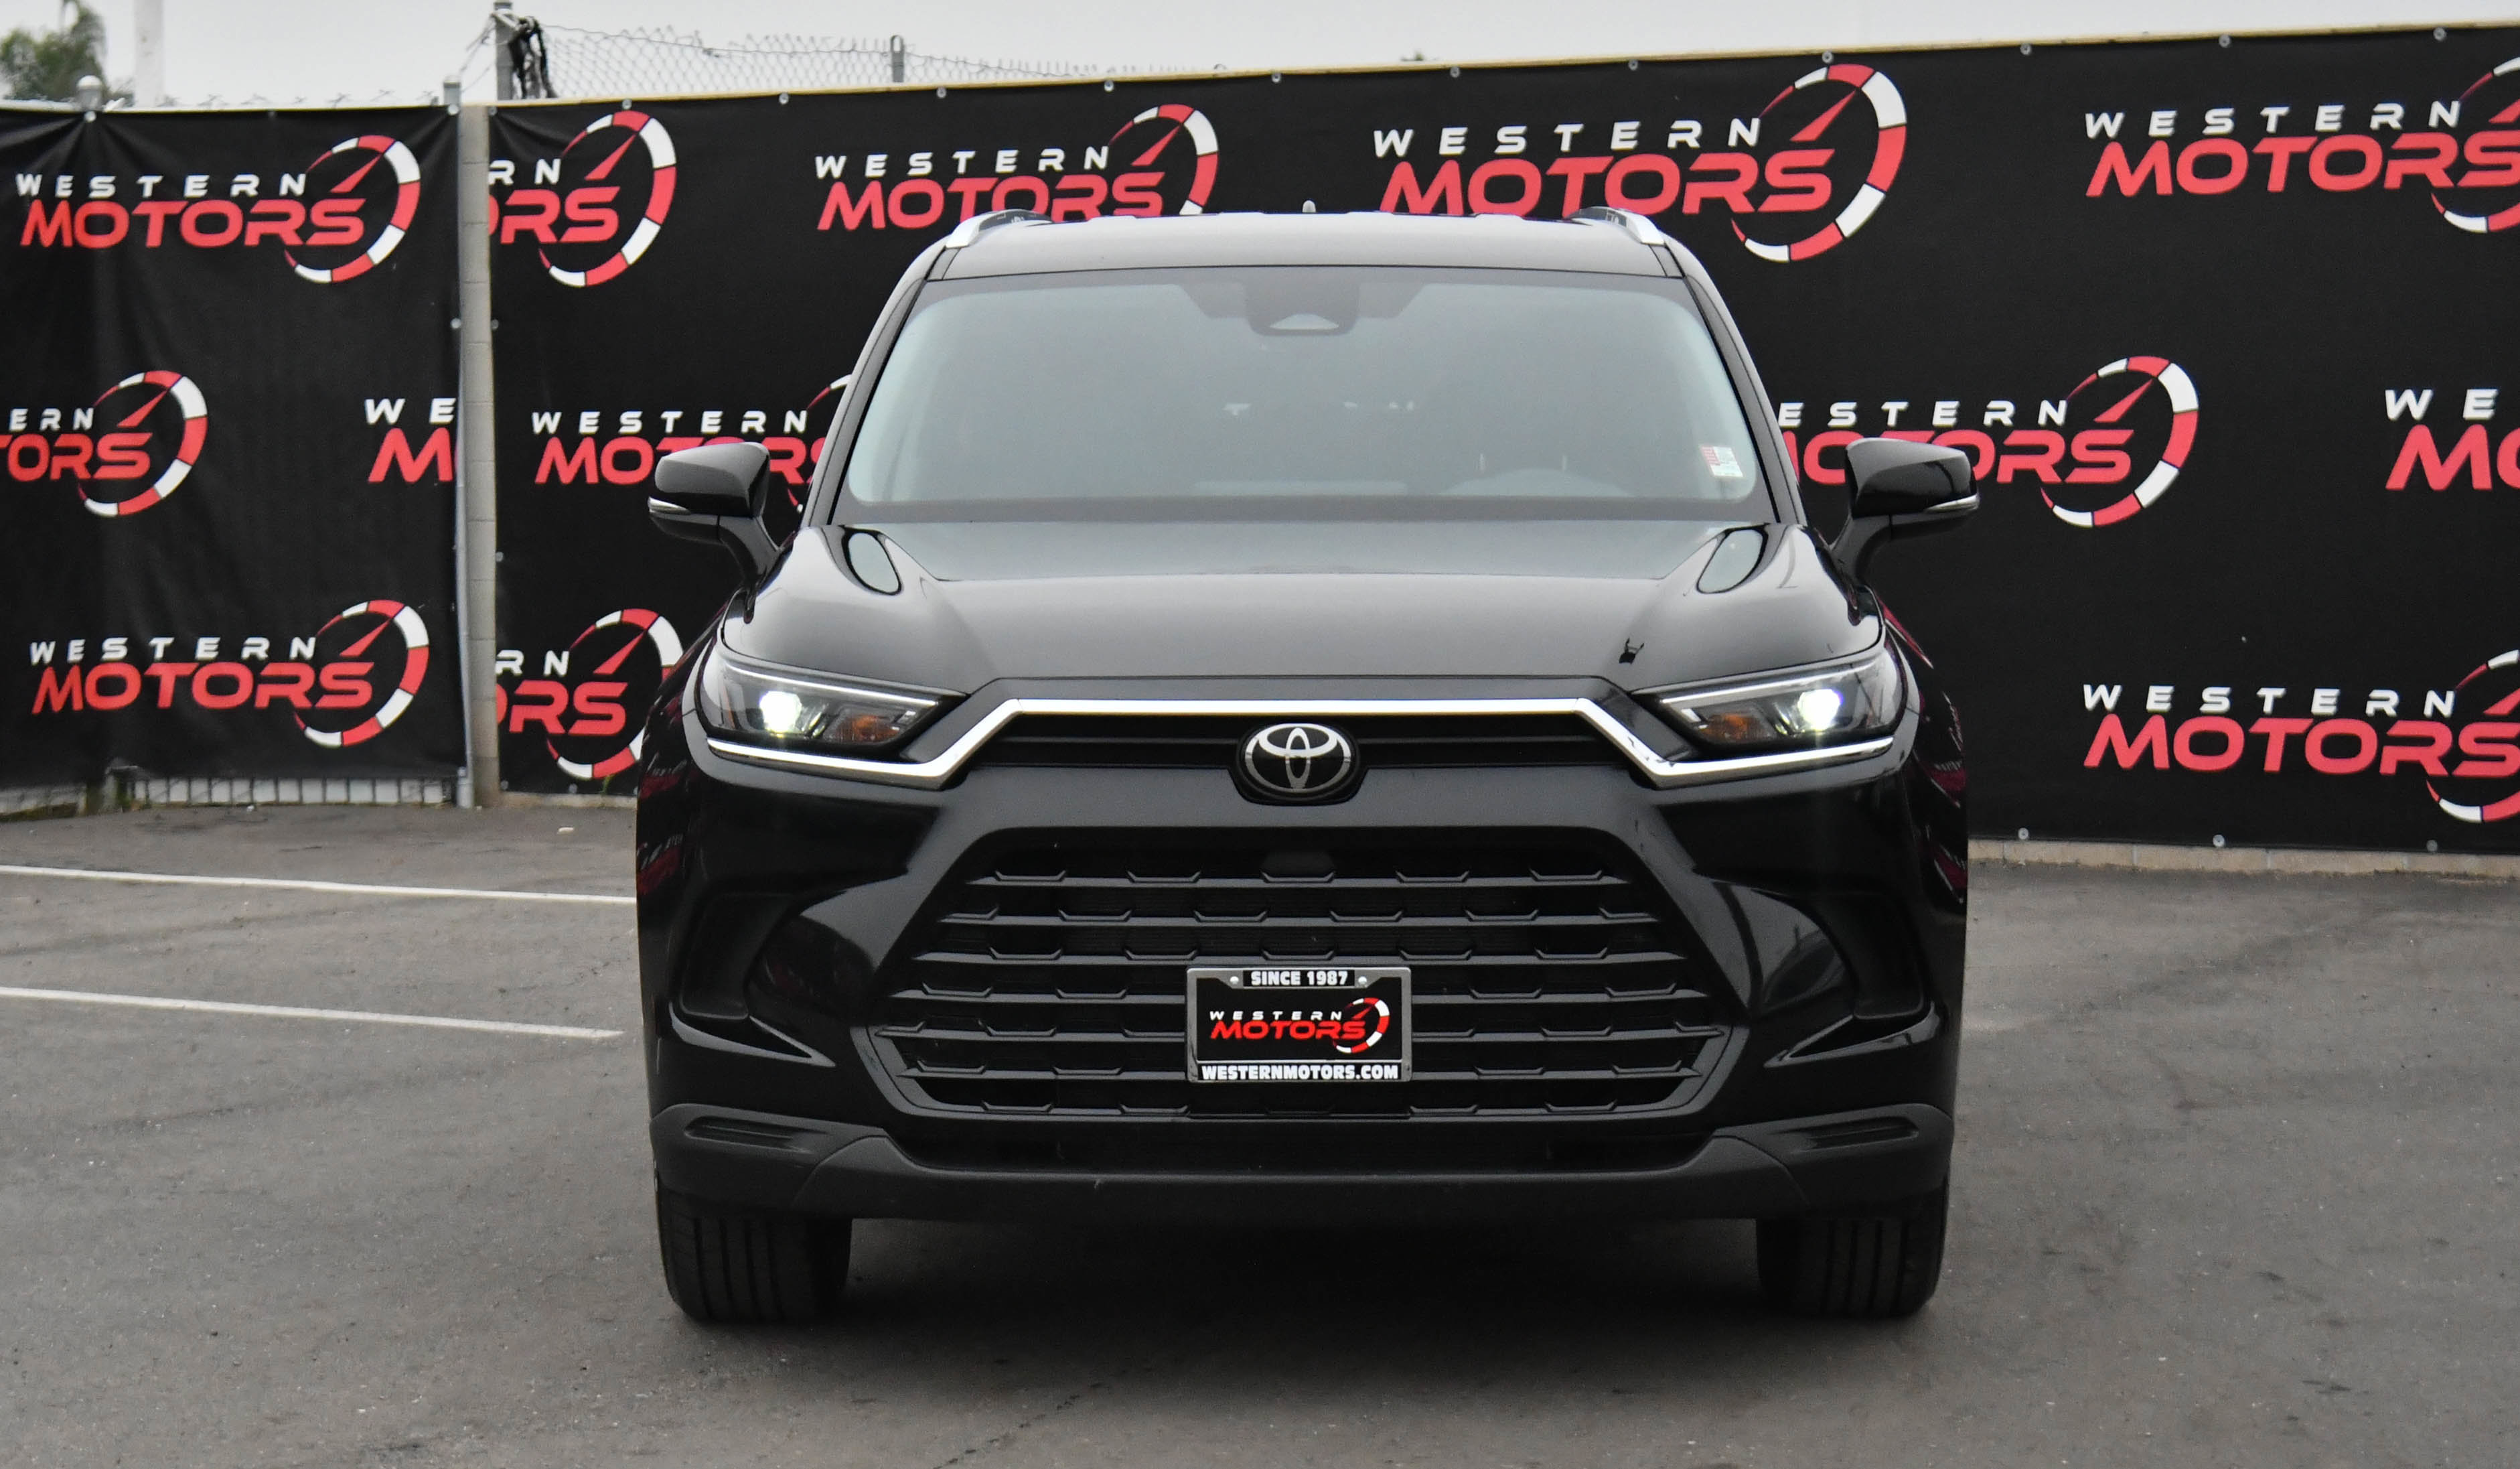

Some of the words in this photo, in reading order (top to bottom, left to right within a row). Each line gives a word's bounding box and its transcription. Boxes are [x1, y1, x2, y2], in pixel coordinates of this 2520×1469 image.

[1374, 118, 1760, 157] WESTERN
[2085, 100, 2460, 139] WESTERN
[815, 145, 1108, 178] WESTERN
[2086, 129, 2520, 196] MOTORS
[15, 173, 307, 198] WESTERN
[817, 171, 1165, 231] MOTORS
[1380, 148, 1835, 217] MOTORS
[21, 198, 366, 249] MOTORS
[489, 186, 621, 244] RS
[532, 410, 808, 434] WESTERN
[1777, 400, 2067, 427] ESTERN
[0, 432, 153, 482] ORS
[30, 636, 316, 664] WESTERN
[32, 661, 374, 714] MOTORS
[2083, 684, 2455, 717] WESTERN
[496, 680, 628, 736] RS
[2083, 713, 2520, 777] MOTORS
[1251, 971, 1301, 987] SINCE
[1307, 971, 1348, 987] 1987
[1209, 1010, 1342, 1021] WESTERN
[1210, 1020, 1366, 1040] MOTORS
[1201, 1064, 1398, 1080] WESTERNMOTORS.COM
